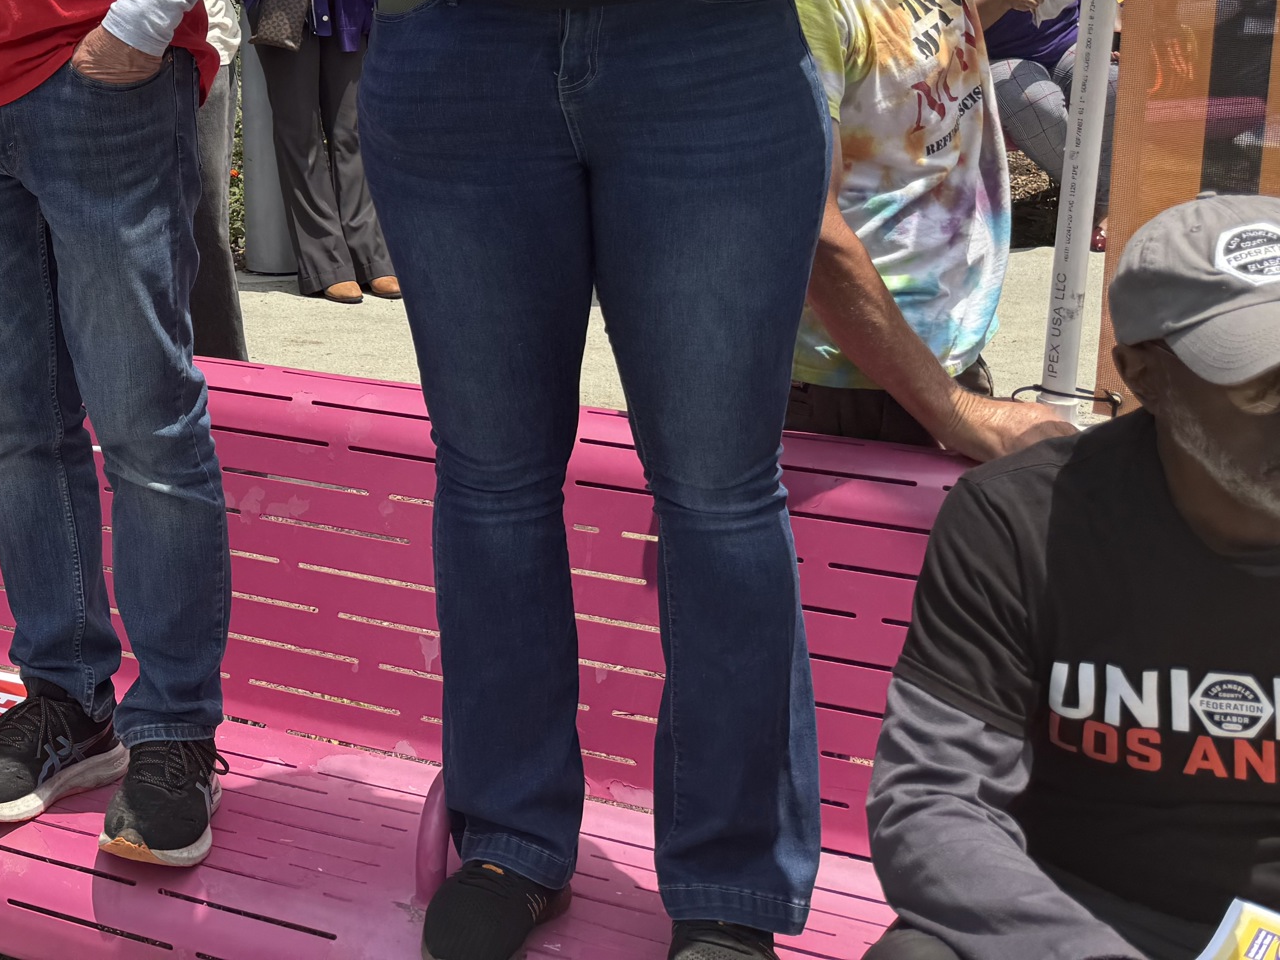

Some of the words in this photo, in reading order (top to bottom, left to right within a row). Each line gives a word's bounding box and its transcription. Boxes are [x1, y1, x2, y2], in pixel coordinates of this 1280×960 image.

[1055, 272, 1067, 301] LLC
[1051, 306, 1063, 337] USA
[1047, 343, 1060, 379] IPEX
[1199, 699, 1264, 714] FEDERATION
[1222, 683, 1255, 700] ANGELES
[1049, 710, 1163, 772] LOS
